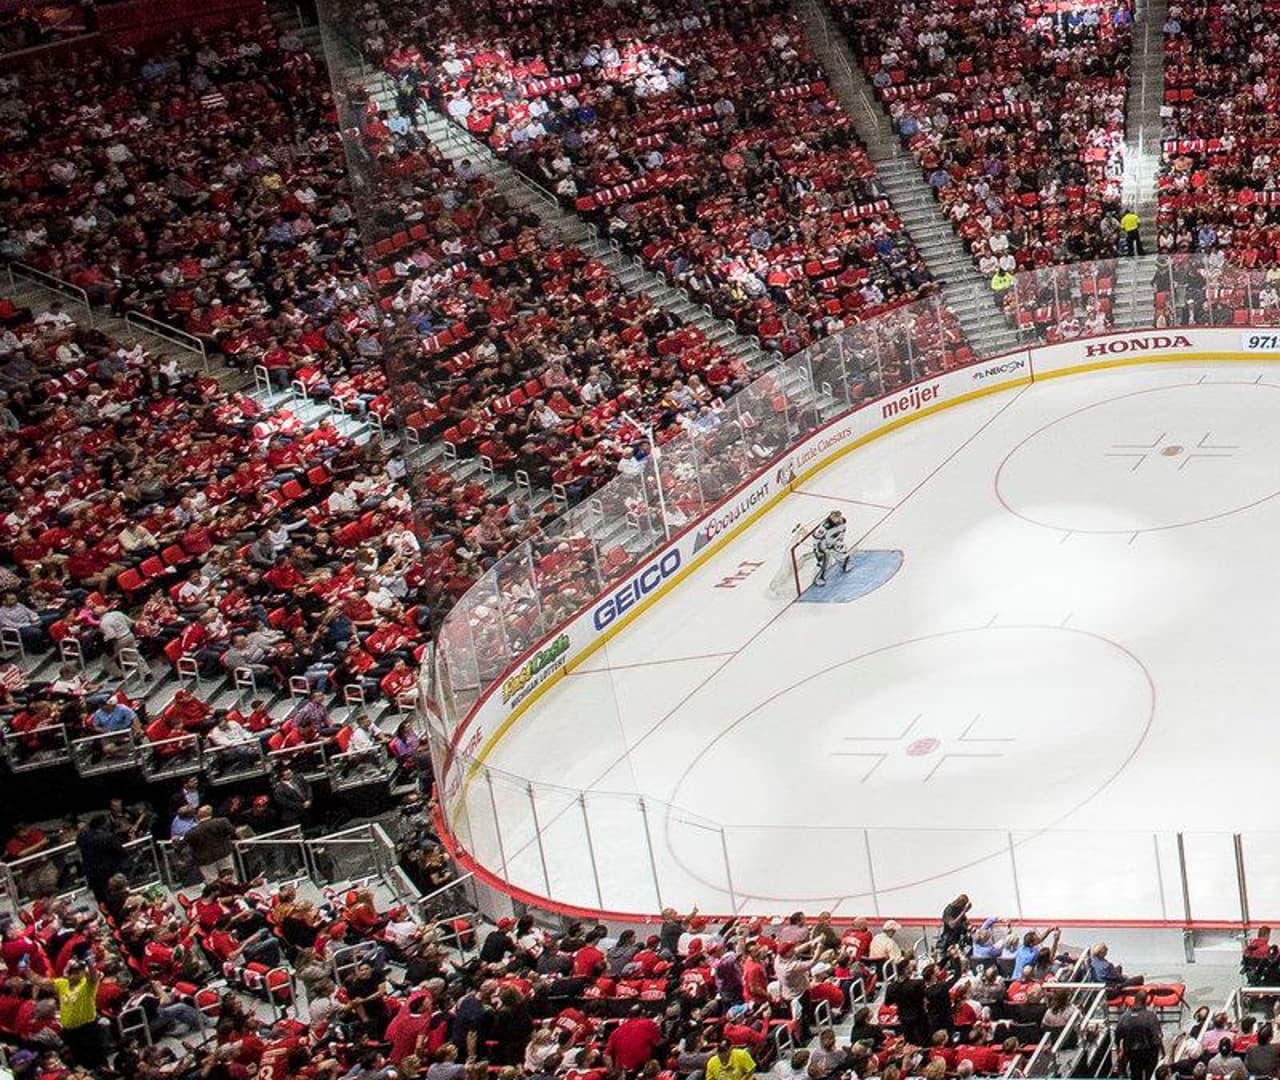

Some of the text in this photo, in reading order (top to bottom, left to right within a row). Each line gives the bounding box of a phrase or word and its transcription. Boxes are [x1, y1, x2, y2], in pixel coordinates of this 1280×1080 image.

[1085, 335, 1193, 358] HONDA
[882, 384, 941, 419] meijer
[741, 482, 769, 513] LIGHT
[592, 547, 682, 632] GEICO
